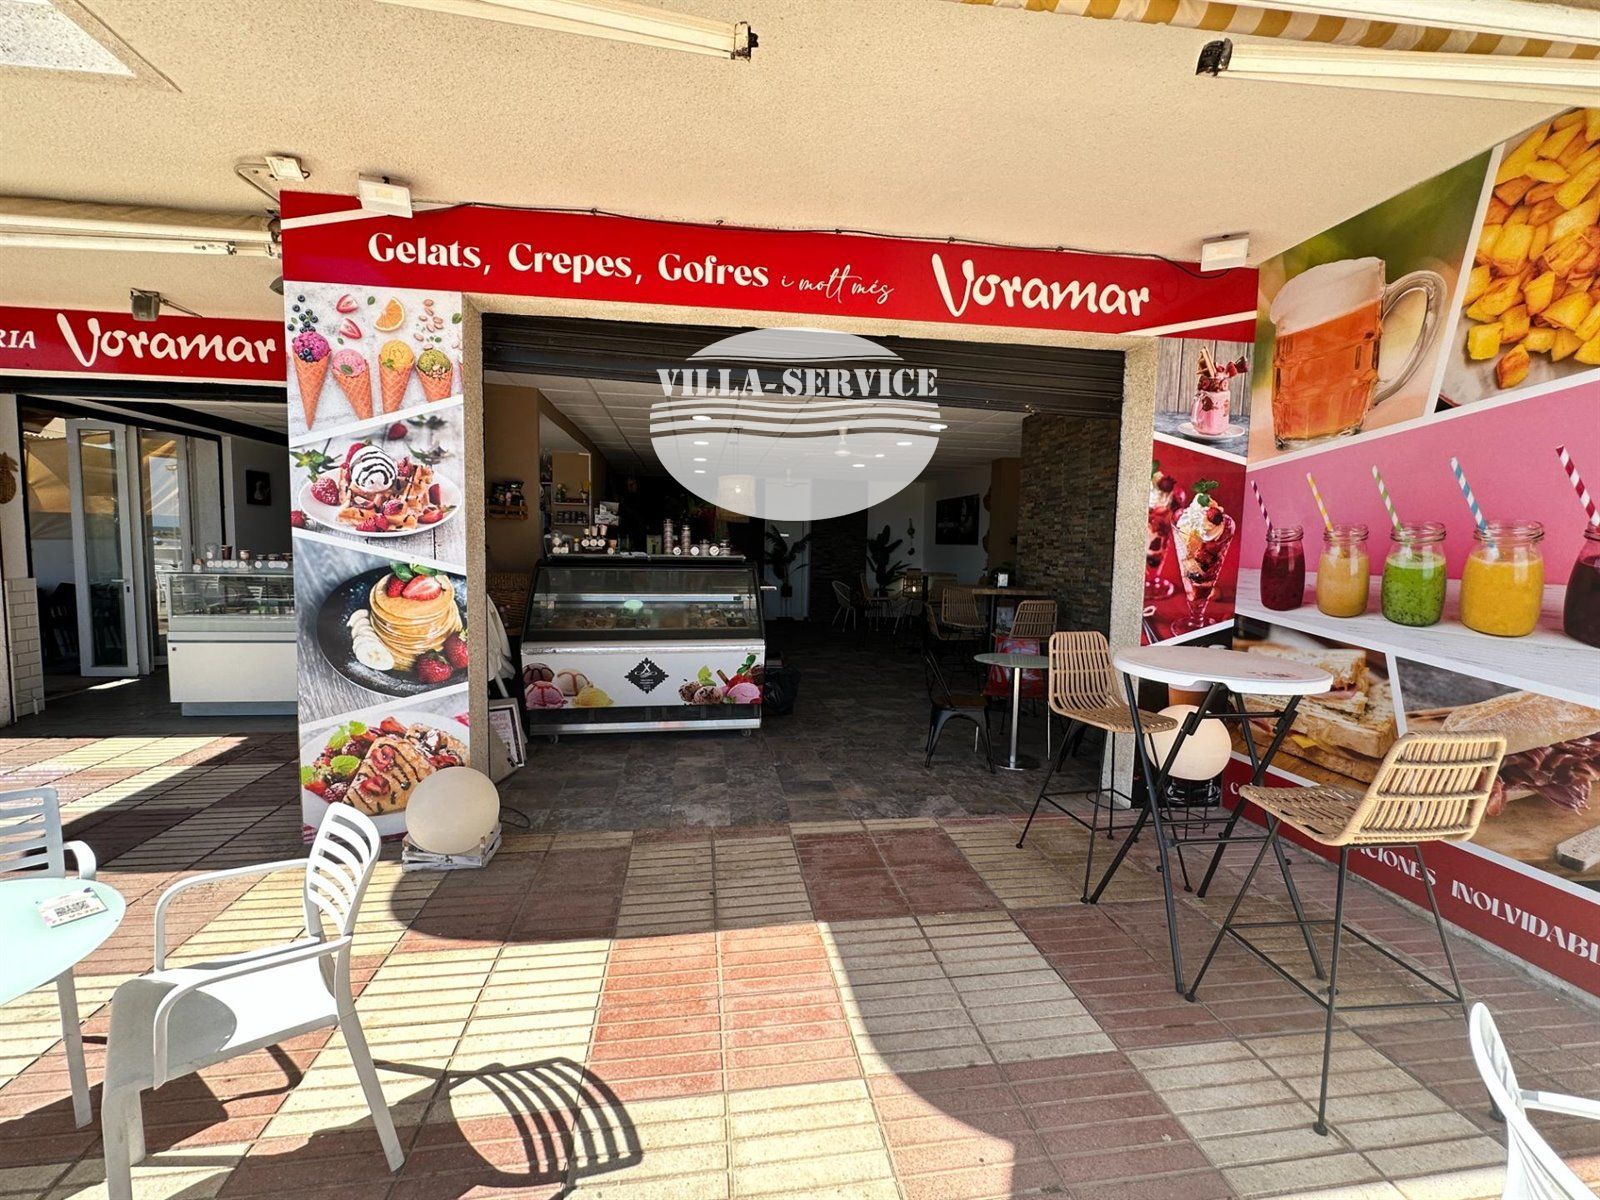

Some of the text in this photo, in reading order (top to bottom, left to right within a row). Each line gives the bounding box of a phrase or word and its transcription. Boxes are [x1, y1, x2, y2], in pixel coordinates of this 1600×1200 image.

[368, 232, 491, 275] Gelats,
[508, 243, 642, 285] Crepes,
[658, 253, 769, 288] Gofres
[799, 264, 862, 304] molt
[931, 253, 1149, 317] Voramar
[56, 312, 277, 367] Voramar
[1360, 847, 1437, 886] CIONES
